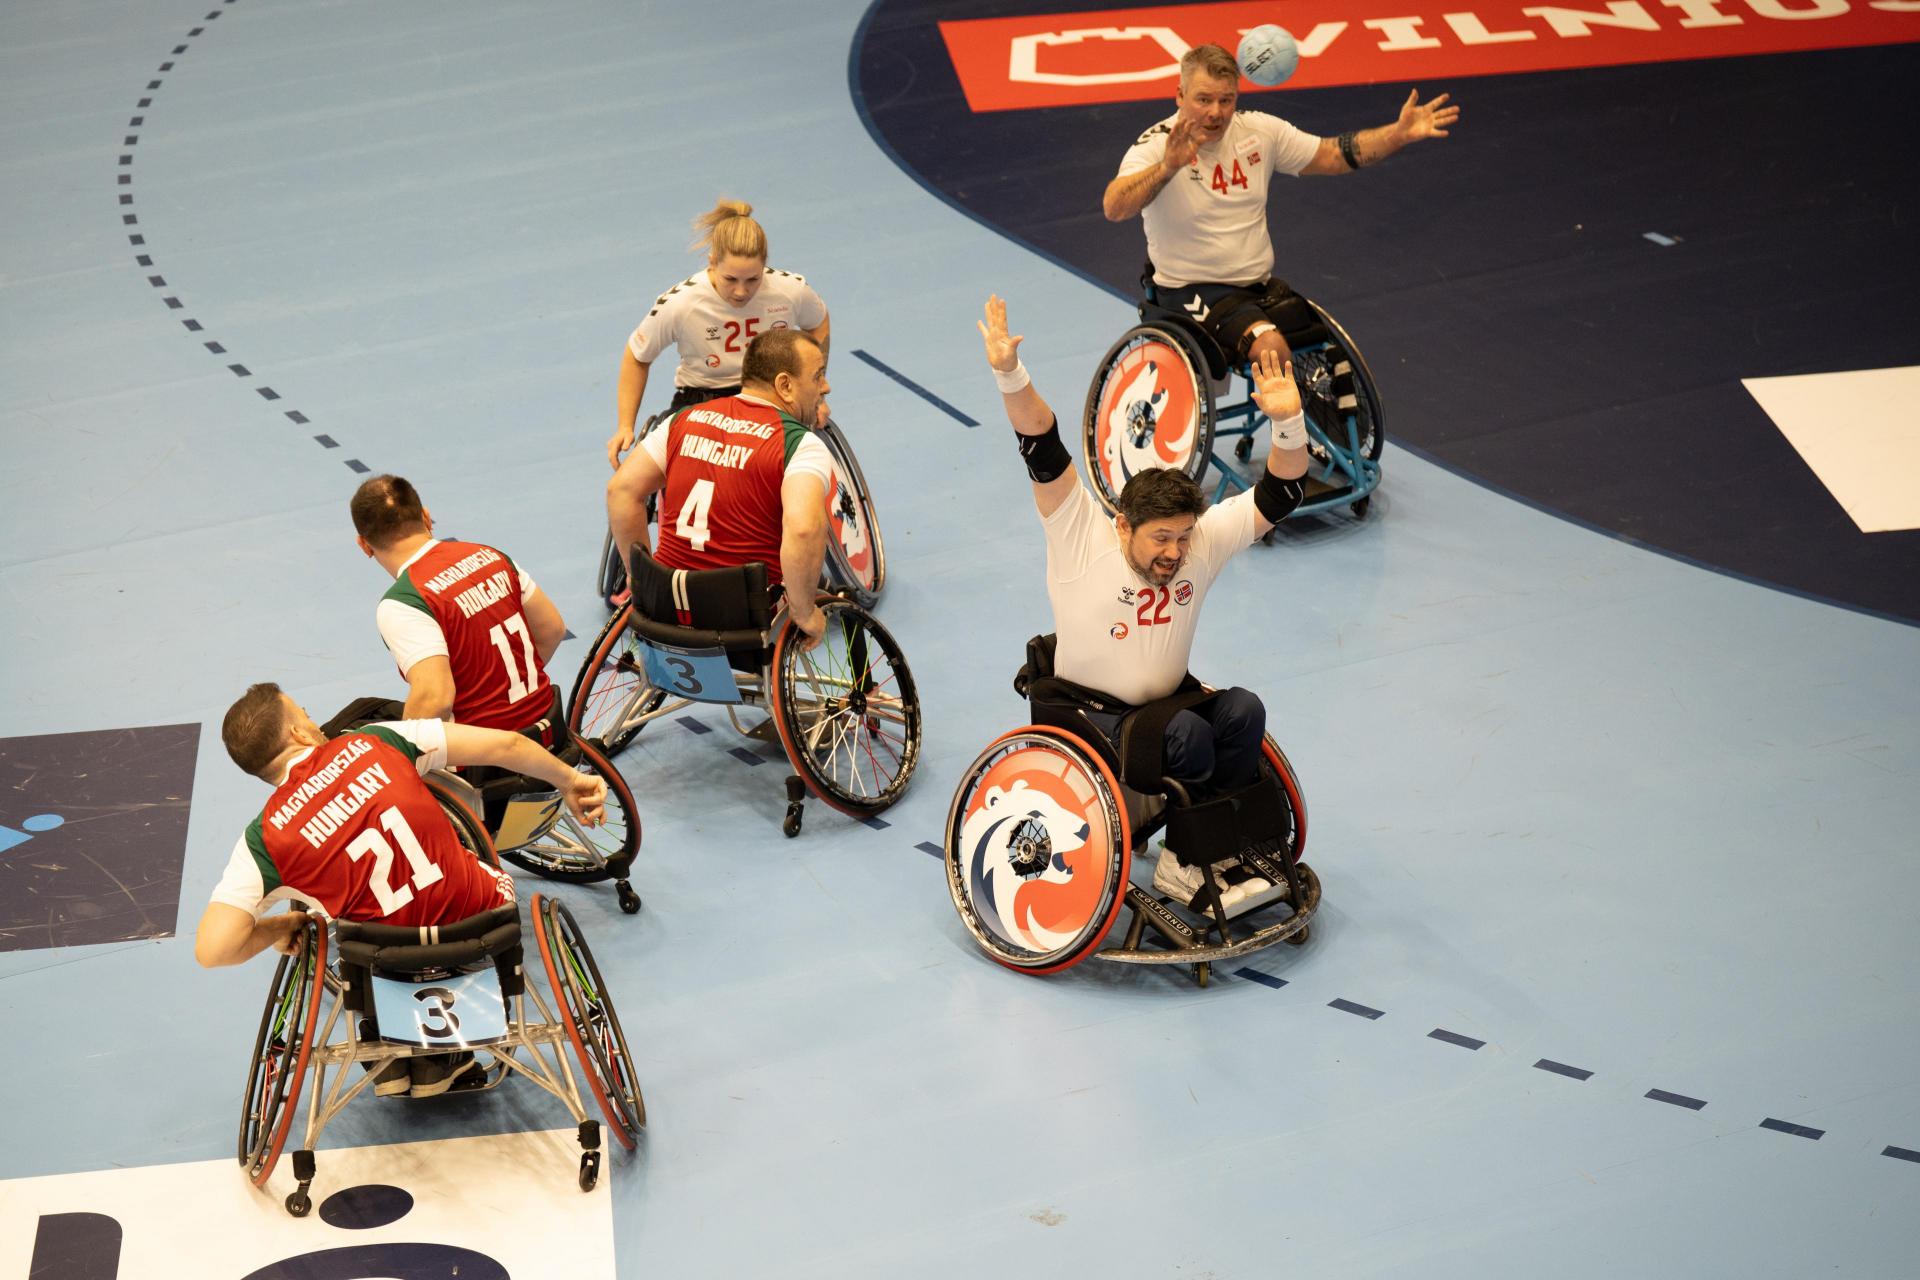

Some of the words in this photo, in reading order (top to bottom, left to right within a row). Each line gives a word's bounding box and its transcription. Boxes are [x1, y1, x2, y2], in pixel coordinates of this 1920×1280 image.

[1212, 158, 1248, 195] 44
[687, 409, 776, 440] MAGYARORSZÁG
[680, 433, 754, 470] HUNGARY
[676, 478, 716, 552] 4
[424, 547, 502, 595] MAGYARORSZÁG
[453, 570, 514, 619] HUNGARY
[1137, 585, 1172, 626] 22
[489, 611, 539, 704] 17
[665, 656, 703, 695] 3
[269, 738, 373, 831] MAGYARORSZÁG
[299, 762, 391, 849] HUNGARY
[344, 805, 444, 917] 21
[1137, 892, 1189, 935] WOLTURNUS
[413, 986, 461, 1038] 3
